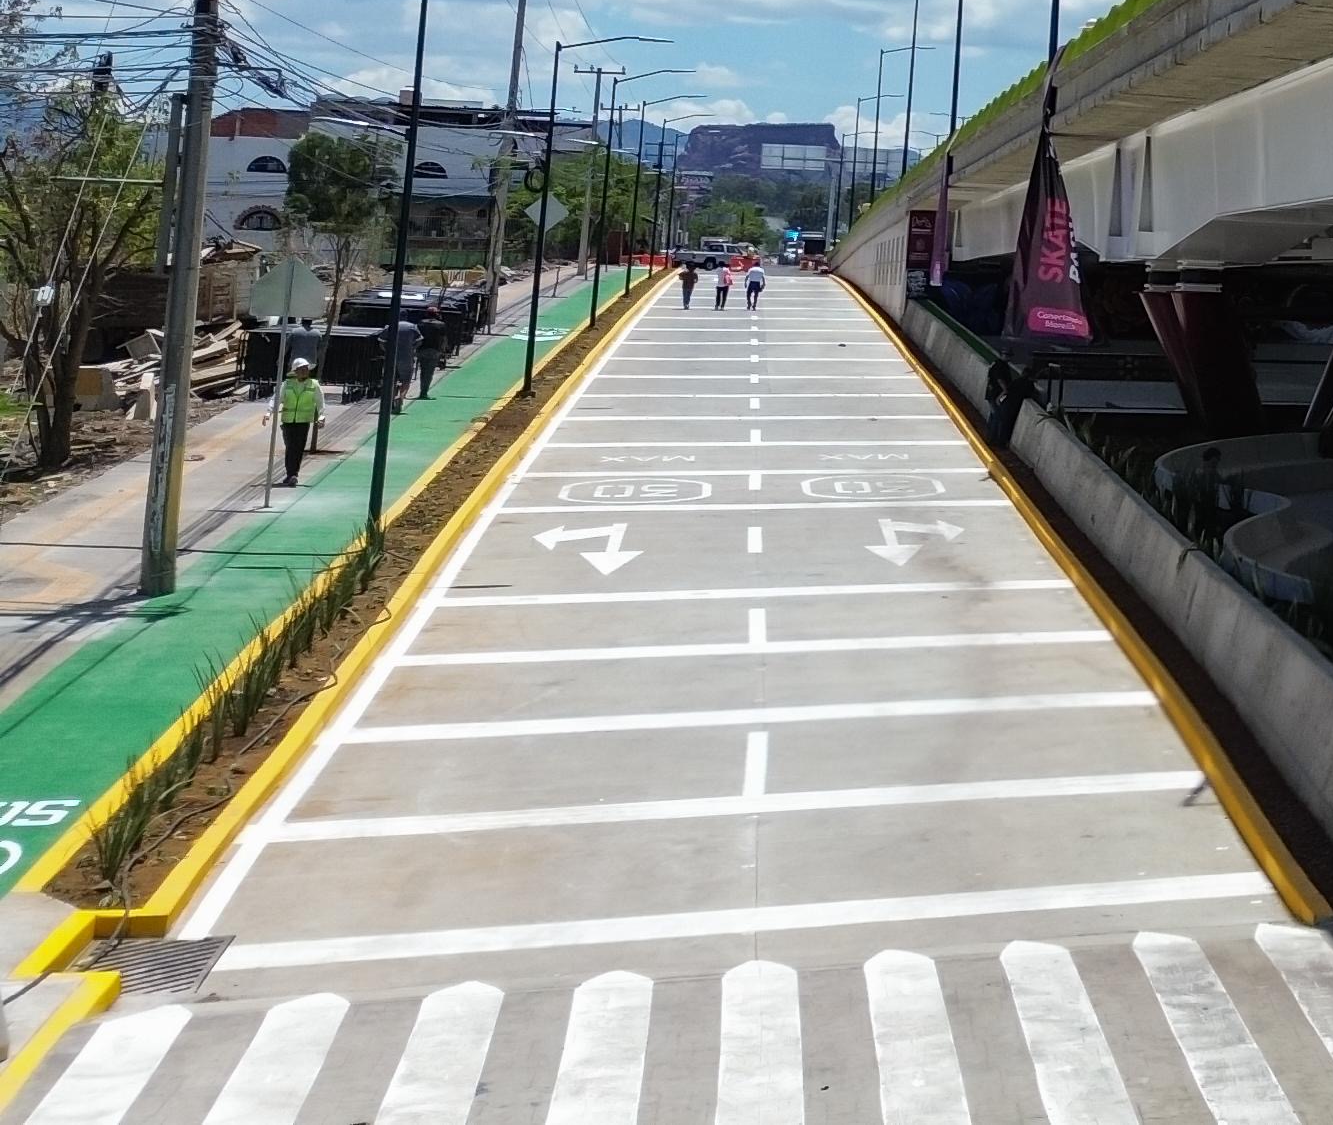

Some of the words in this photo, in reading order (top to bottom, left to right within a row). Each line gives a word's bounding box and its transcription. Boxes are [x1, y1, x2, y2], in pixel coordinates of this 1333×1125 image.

[1038, 197, 1068, 283] SKATE
[600, 455, 696, 463] MAX
[593, 484, 679, 498] 30
